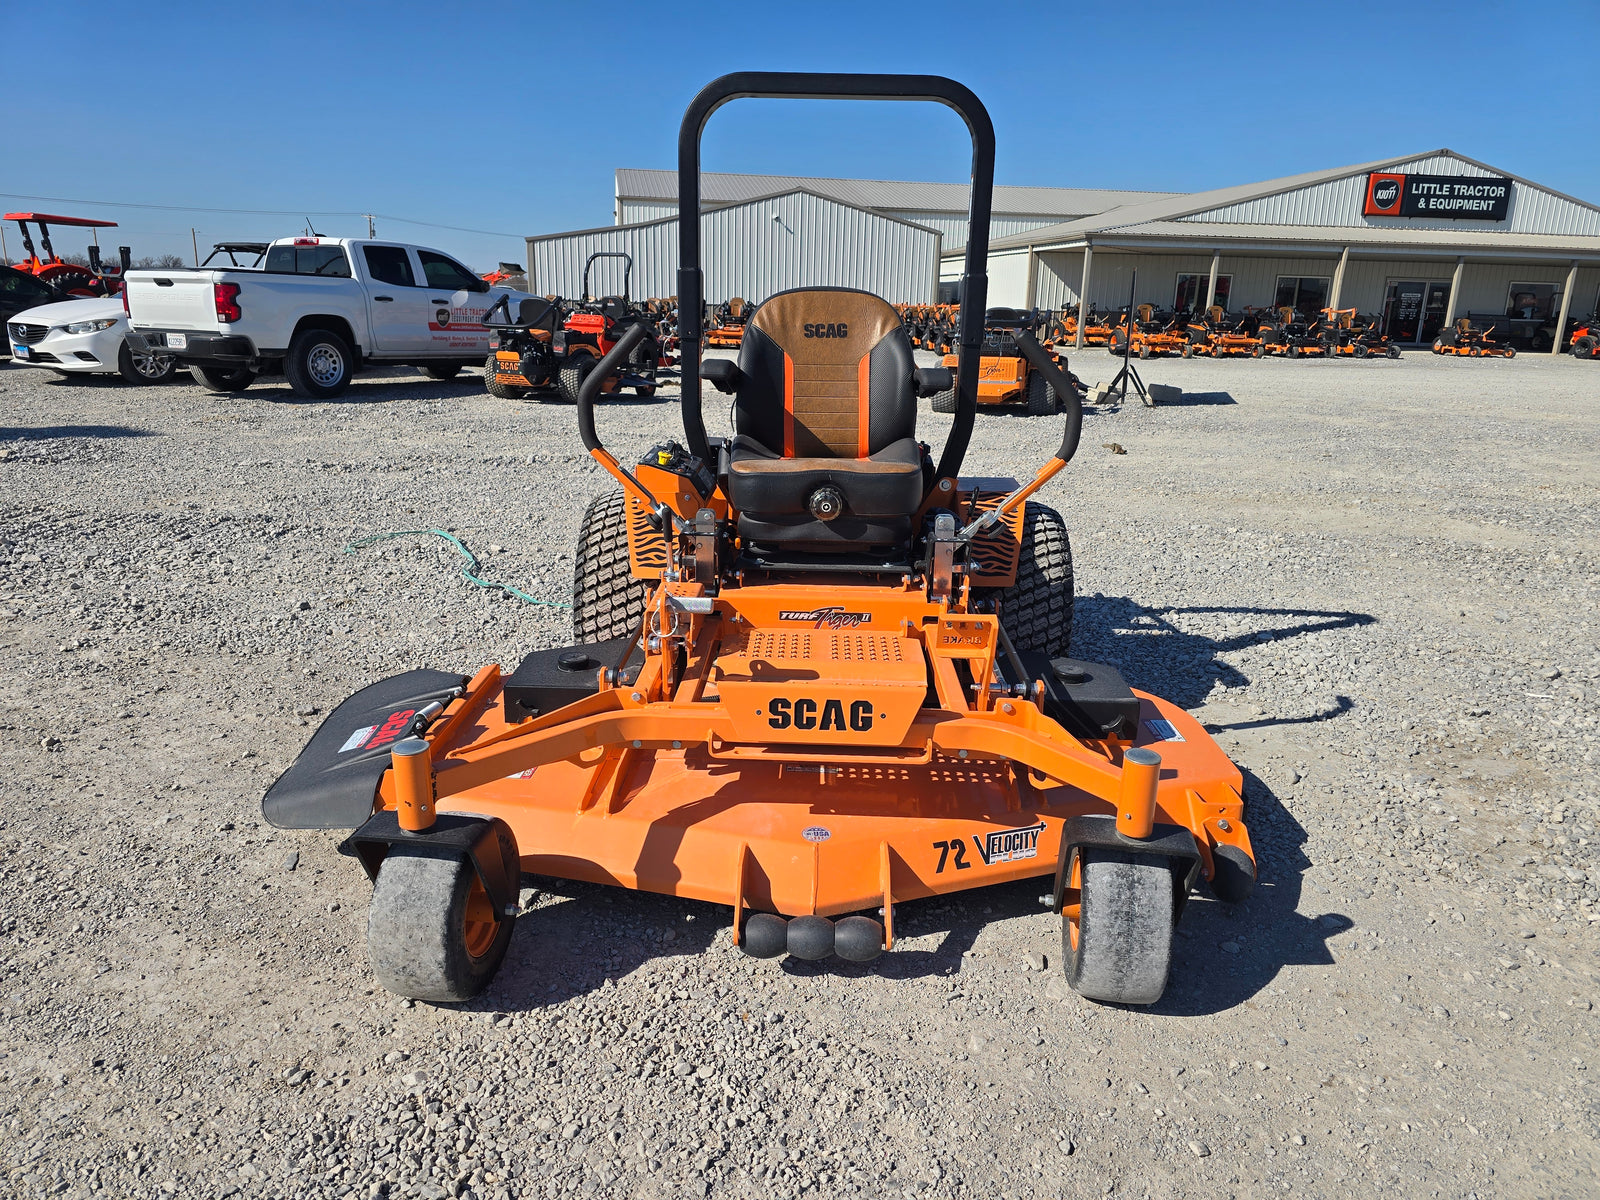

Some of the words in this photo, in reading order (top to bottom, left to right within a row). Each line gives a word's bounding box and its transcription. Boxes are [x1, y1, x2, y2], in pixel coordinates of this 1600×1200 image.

[1376, 188, 1396, 200] KIOTI
[1411, 183, 1450, 195] LITTLE
[1453, 185, 1505, 197] TRACTOR
[1418, 198, 1426, 209] &
[1429, 198, 1495, 211] EQUIPMENT
[469, 308, 488, 316] TRACT
[803, 323, 848, 339] SCAG
[500, 361, 519, 371] SCAG
[780, 612, 820, 620] TURF
[811, 606, 861, 630] Tiger
[768, 698, 873, 732] SCAG
[933, 838, 971, 874] 72
